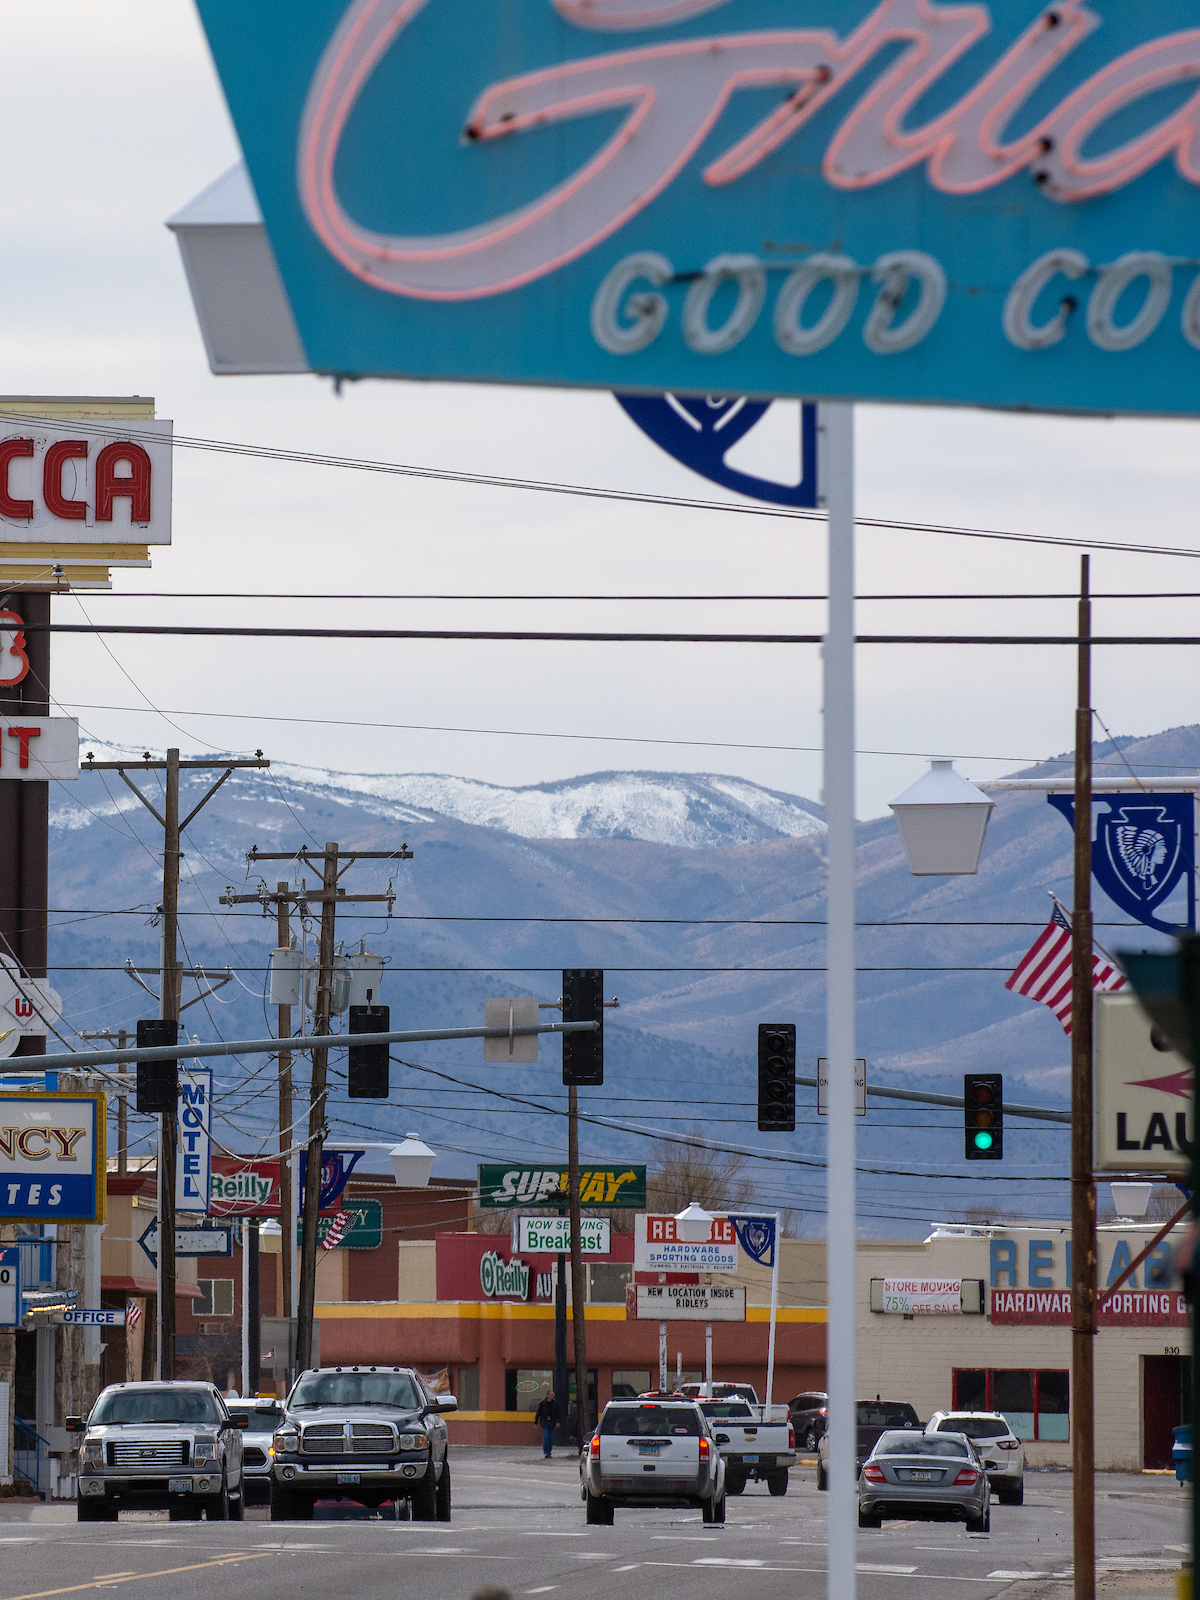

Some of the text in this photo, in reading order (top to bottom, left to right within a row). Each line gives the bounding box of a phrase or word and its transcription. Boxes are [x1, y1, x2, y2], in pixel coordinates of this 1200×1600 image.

[590, 248, 1200, 356] GOOD CO
[182, 1084, 205, 1197] MOTEL
[491, 1169, 638, 1202] SUBWAY
[527, 1220, 603, 1230] NOW SEVING
[528, 1231, 602, 1250] Breakast
[664, 1245, 720, 1254] HARDWARE
[650, 1254, 734, 1263] SPORTING GOODS
[647, 1287, 734, 1298] NEW LOCATION INSIDE
[884, 1281, 960, 1293] STORE MOVING
[676, 1299, 709, 1308] RIDLEYS
[885, 1296, 959, 1315] 75% OFF SALE
[995, 1293, 1072, 1312] HARDWAR
[1097, 1293, 1170, 1314] PORTING
[63, 1312, 114, 1323] OFFICE
[1164, 1347, 1180, 1355] 930
